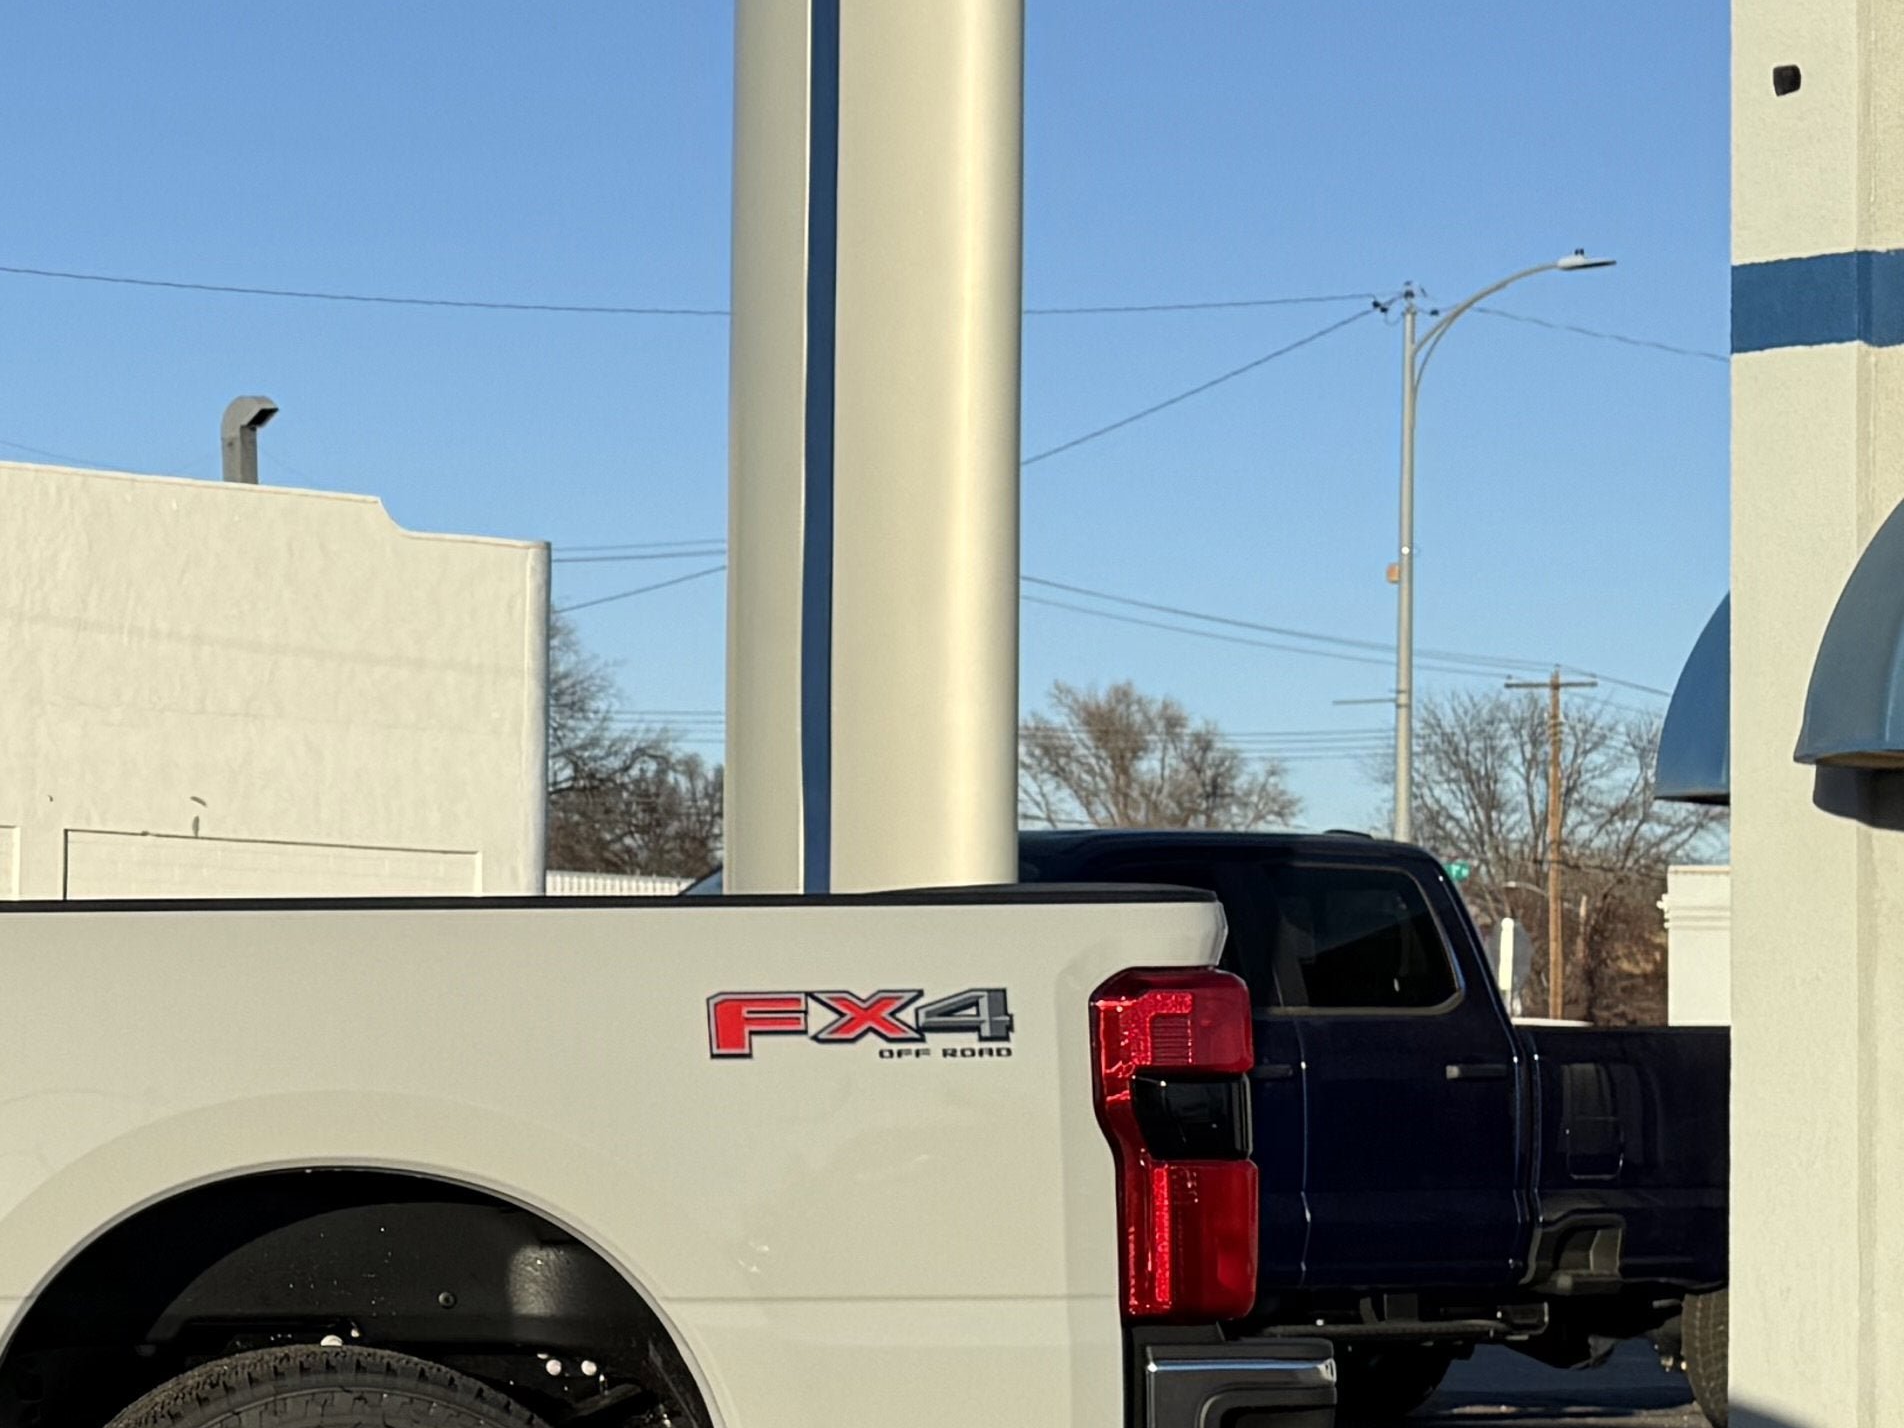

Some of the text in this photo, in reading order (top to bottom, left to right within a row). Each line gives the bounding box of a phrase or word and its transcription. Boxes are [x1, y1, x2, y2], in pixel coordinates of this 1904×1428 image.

[707, 988, 1014, 1059] FX4
[879, 1047, 1013, 1059] OFF ROAD
